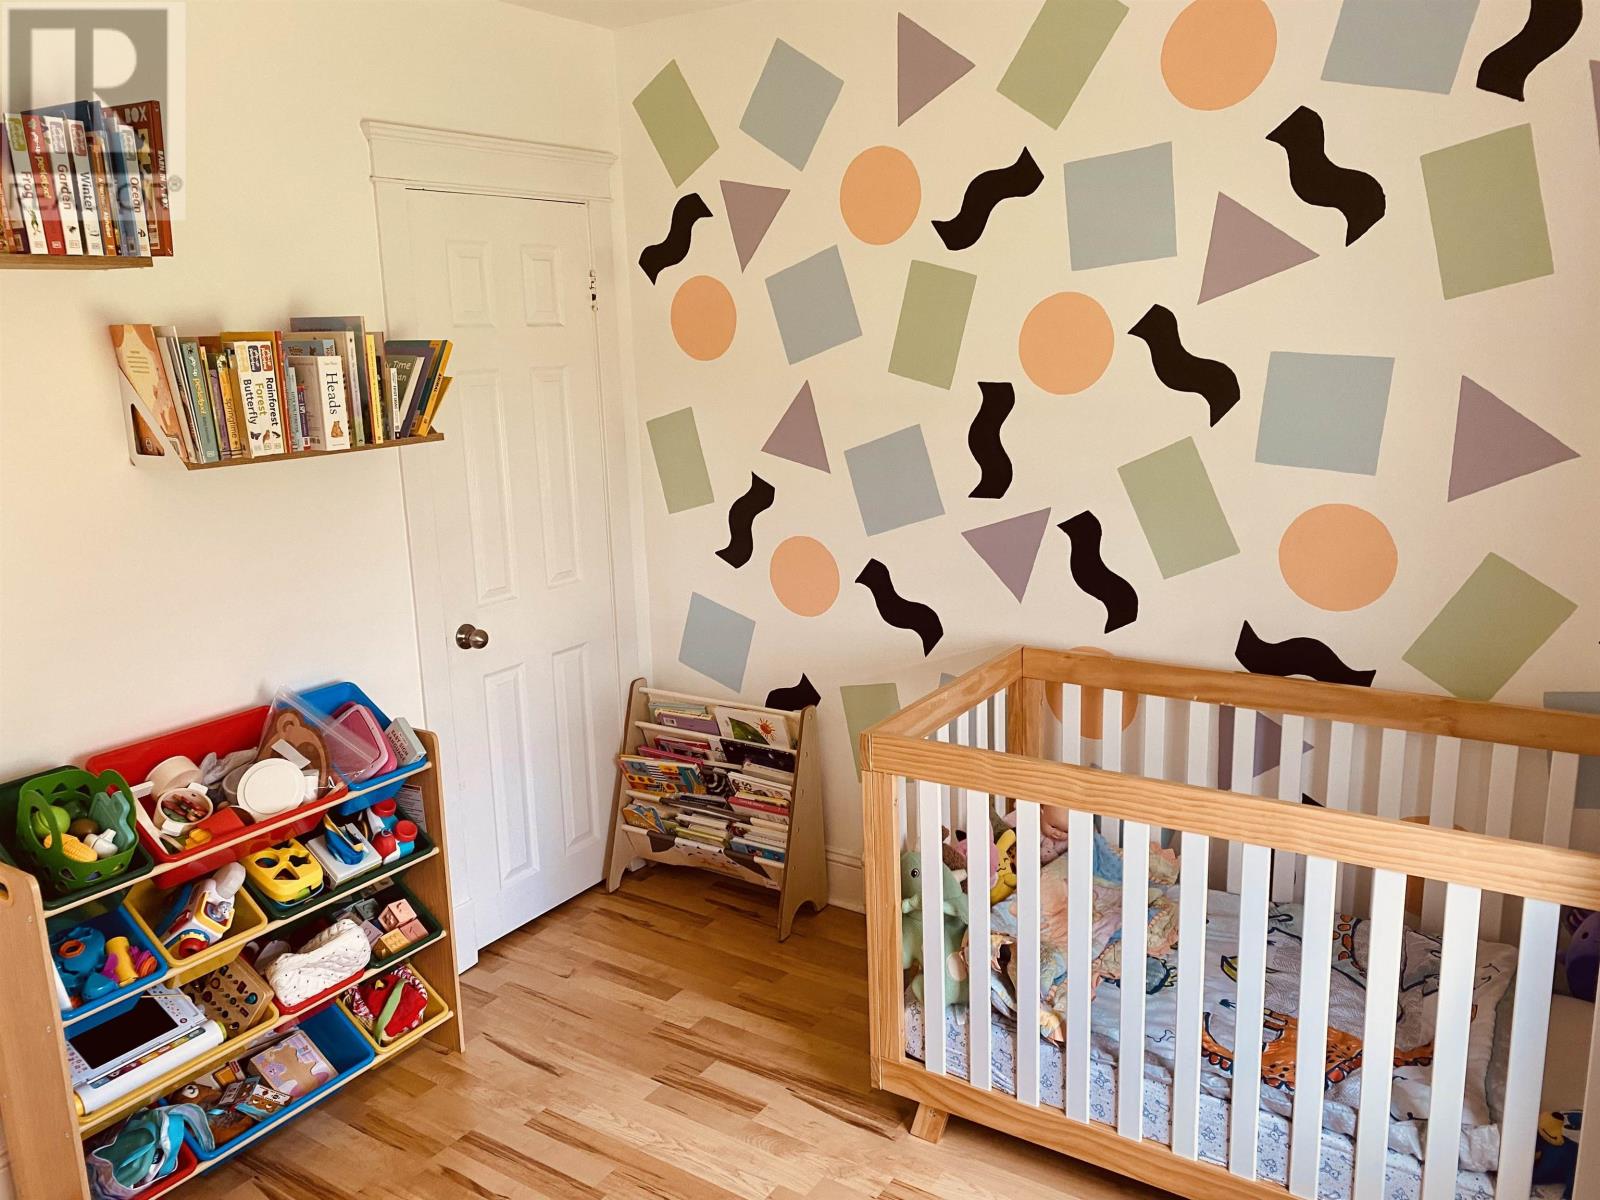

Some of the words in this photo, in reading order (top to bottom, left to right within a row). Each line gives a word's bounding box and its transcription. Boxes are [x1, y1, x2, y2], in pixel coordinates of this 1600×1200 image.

[124, 106, 148, 124] BOX
[21, 171, 34, 200] Frog
[57, 163, 72, 210] Garden
[79, 171, 93, 213] Winter
[129, 176, 141, 213] Ocean
[393, 360, 412, 370] Time
[244, 379, 258, 424] Butterfly
[255, 383, 268, 416] Forest
[266, 377, 280, 426] Rainforest
[326, 372, 341, 415] Heads
[386, 732, 406, 762] LANGUAGE
[391, 728, 401, 742] EASY
[399, 742, 409, 757] SIGN
